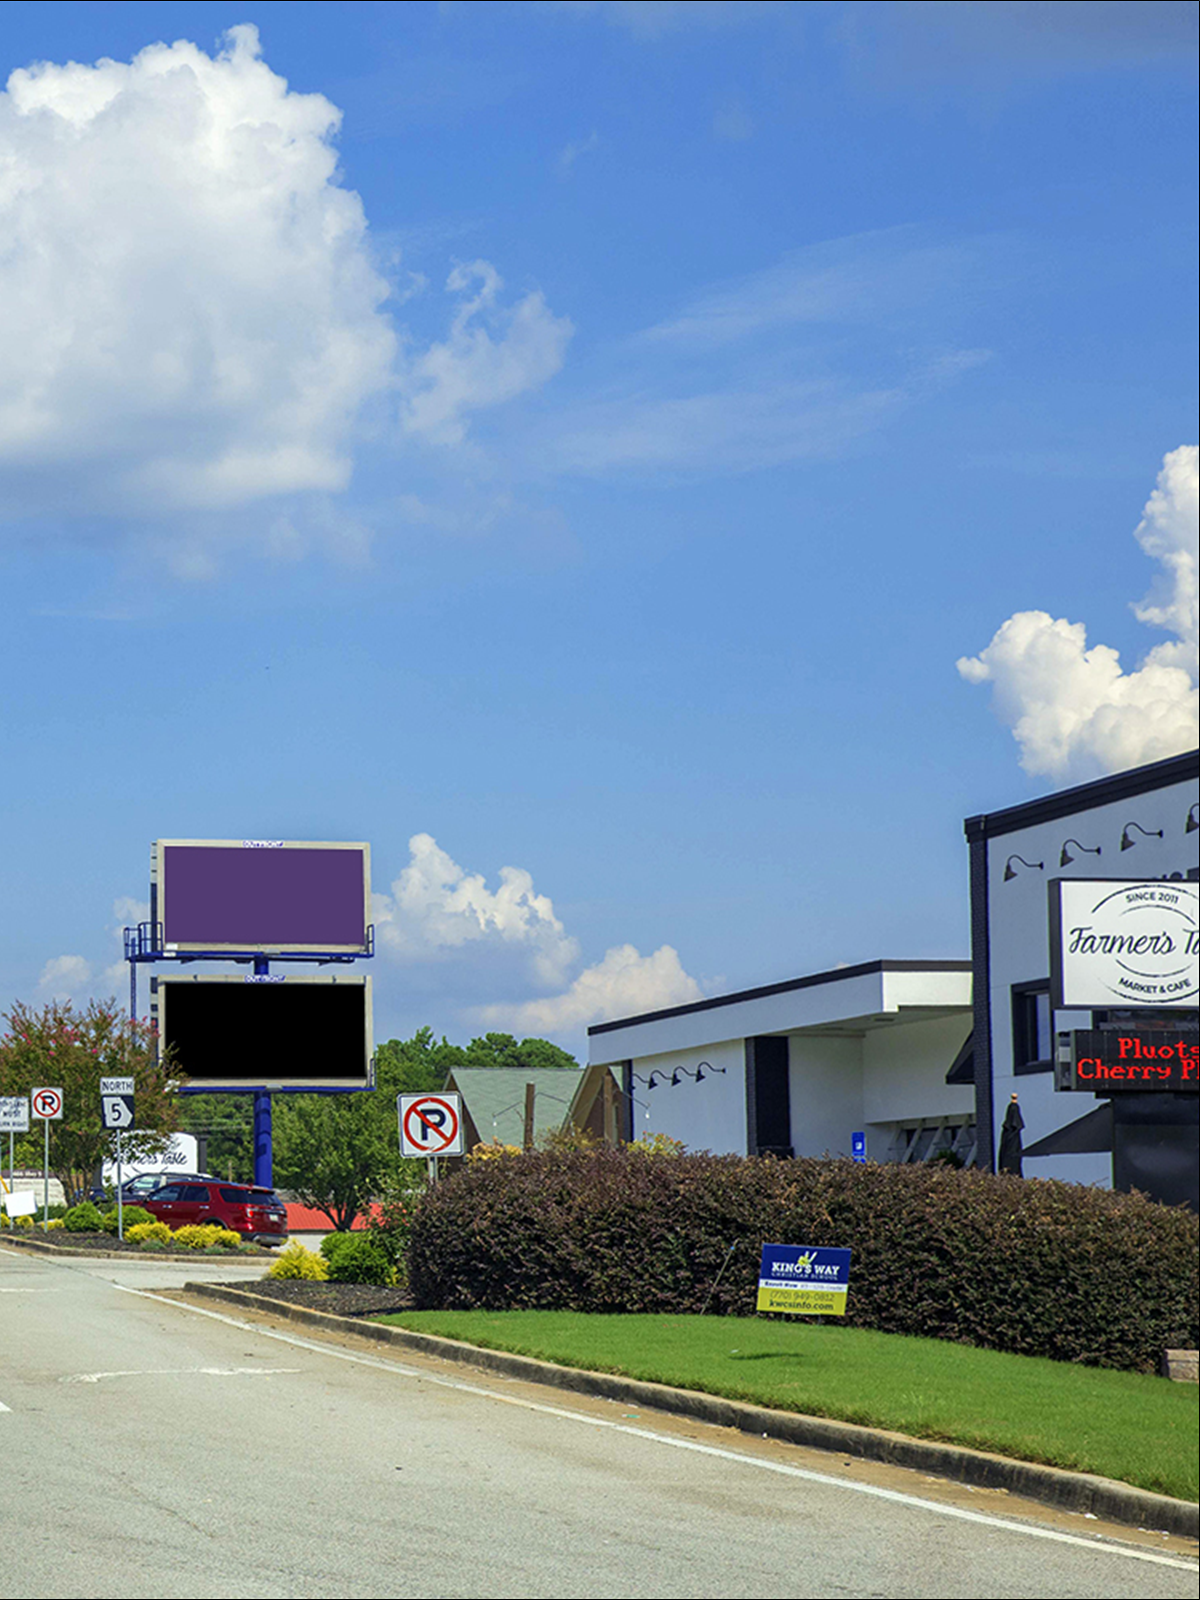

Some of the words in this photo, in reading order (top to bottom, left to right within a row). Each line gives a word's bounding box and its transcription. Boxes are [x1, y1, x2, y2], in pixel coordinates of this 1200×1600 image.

[1126, 892, 1156, 903] SINCE
[1158, 892, 1180, 904] 2011
[1069, 926, 1177, 955] Farmer's
[1119, 977, 1158, 994] MARKET
[1159, 984, 1166, 993] &
[1166, 978, 1192, 992] CAFE
[1077, 1058, 1172, 1079] Cherry
[102, 1081, 133, 1091] NORTH
[111, 1103, 122, 1121] 5
[814, 1264, 840, 1276] WAY
[810, 1273, 839, 1281] SCHOOL
[769, 1290, 791, 1301] (770)
[769, 1299, 834, 1311] kwcsinfo.com
